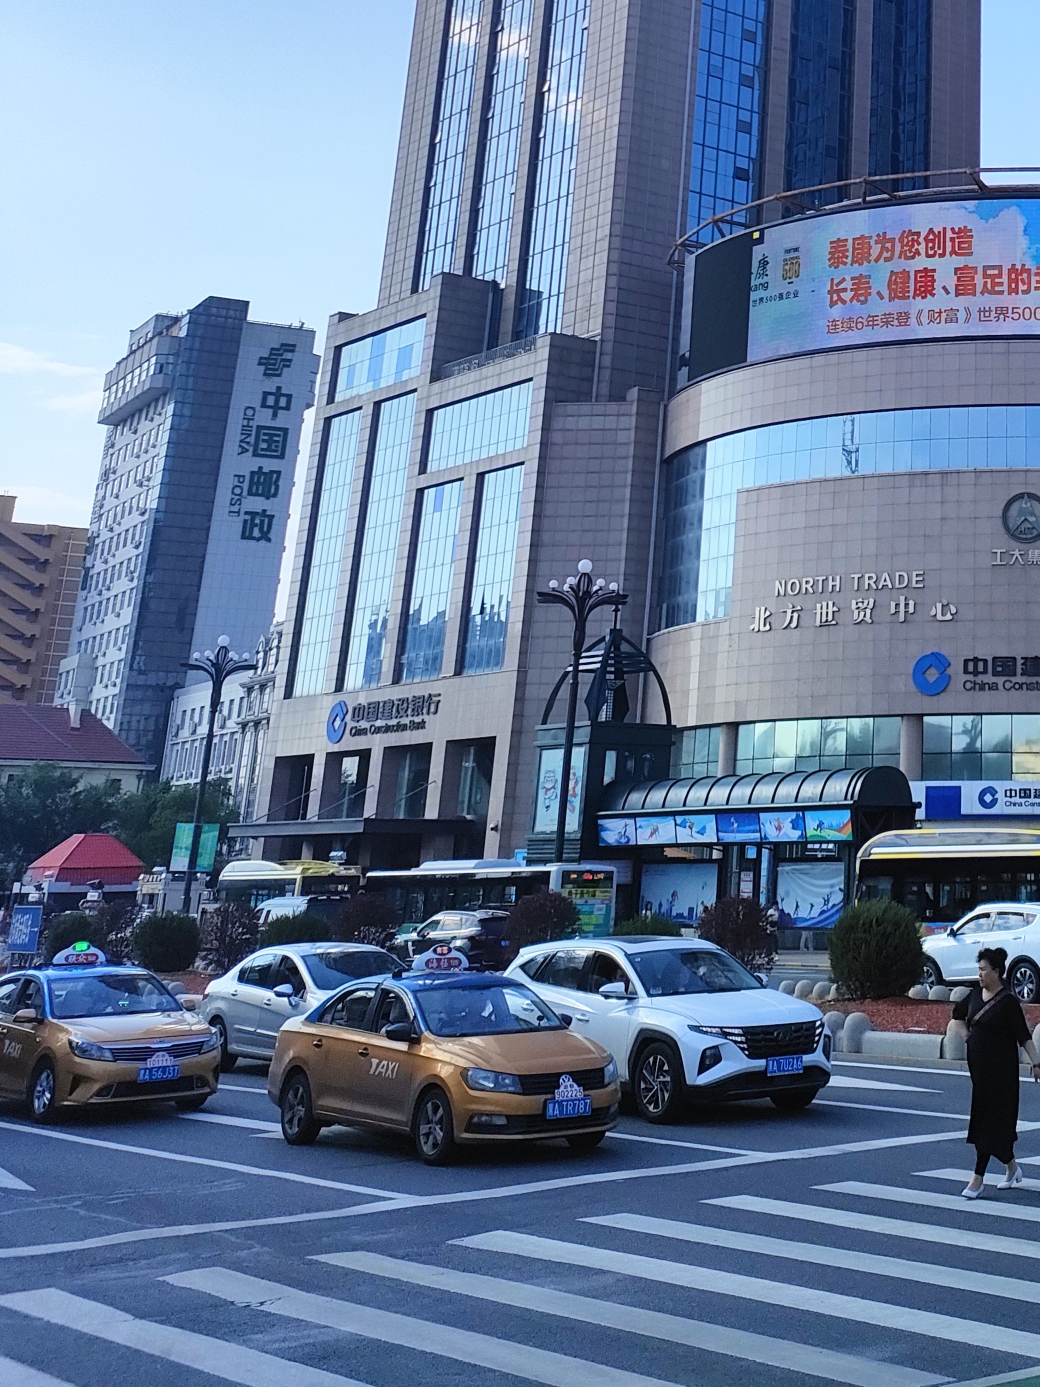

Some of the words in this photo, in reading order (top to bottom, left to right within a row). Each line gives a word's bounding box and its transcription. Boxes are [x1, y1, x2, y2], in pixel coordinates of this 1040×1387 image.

[827, 225, 974, 269] 泰康为您创造
[752, 253, 770, 281] 康
[752, 289, 799, 307] 世界500强企业
[237, 406, 256, 455] CHINA
[240, 386, 293, 542] 中国邮政
[228, 474, 246, 517] POST
[774, 575, 841, 597] NORTH
[851, 571, 925, 592] TRADE
[750, 595, 957, 632] 北方世贸中心
[963, 679, 999, 691] China
[351, 693, 442, 723] 中国建设银行
[1005, 800, 1023, 808] China
[3, 1039, 22, 1058] TAXI
[369, 1058, 399, 1079] TAXI
[556, 1088, 583, 1099] 902225
